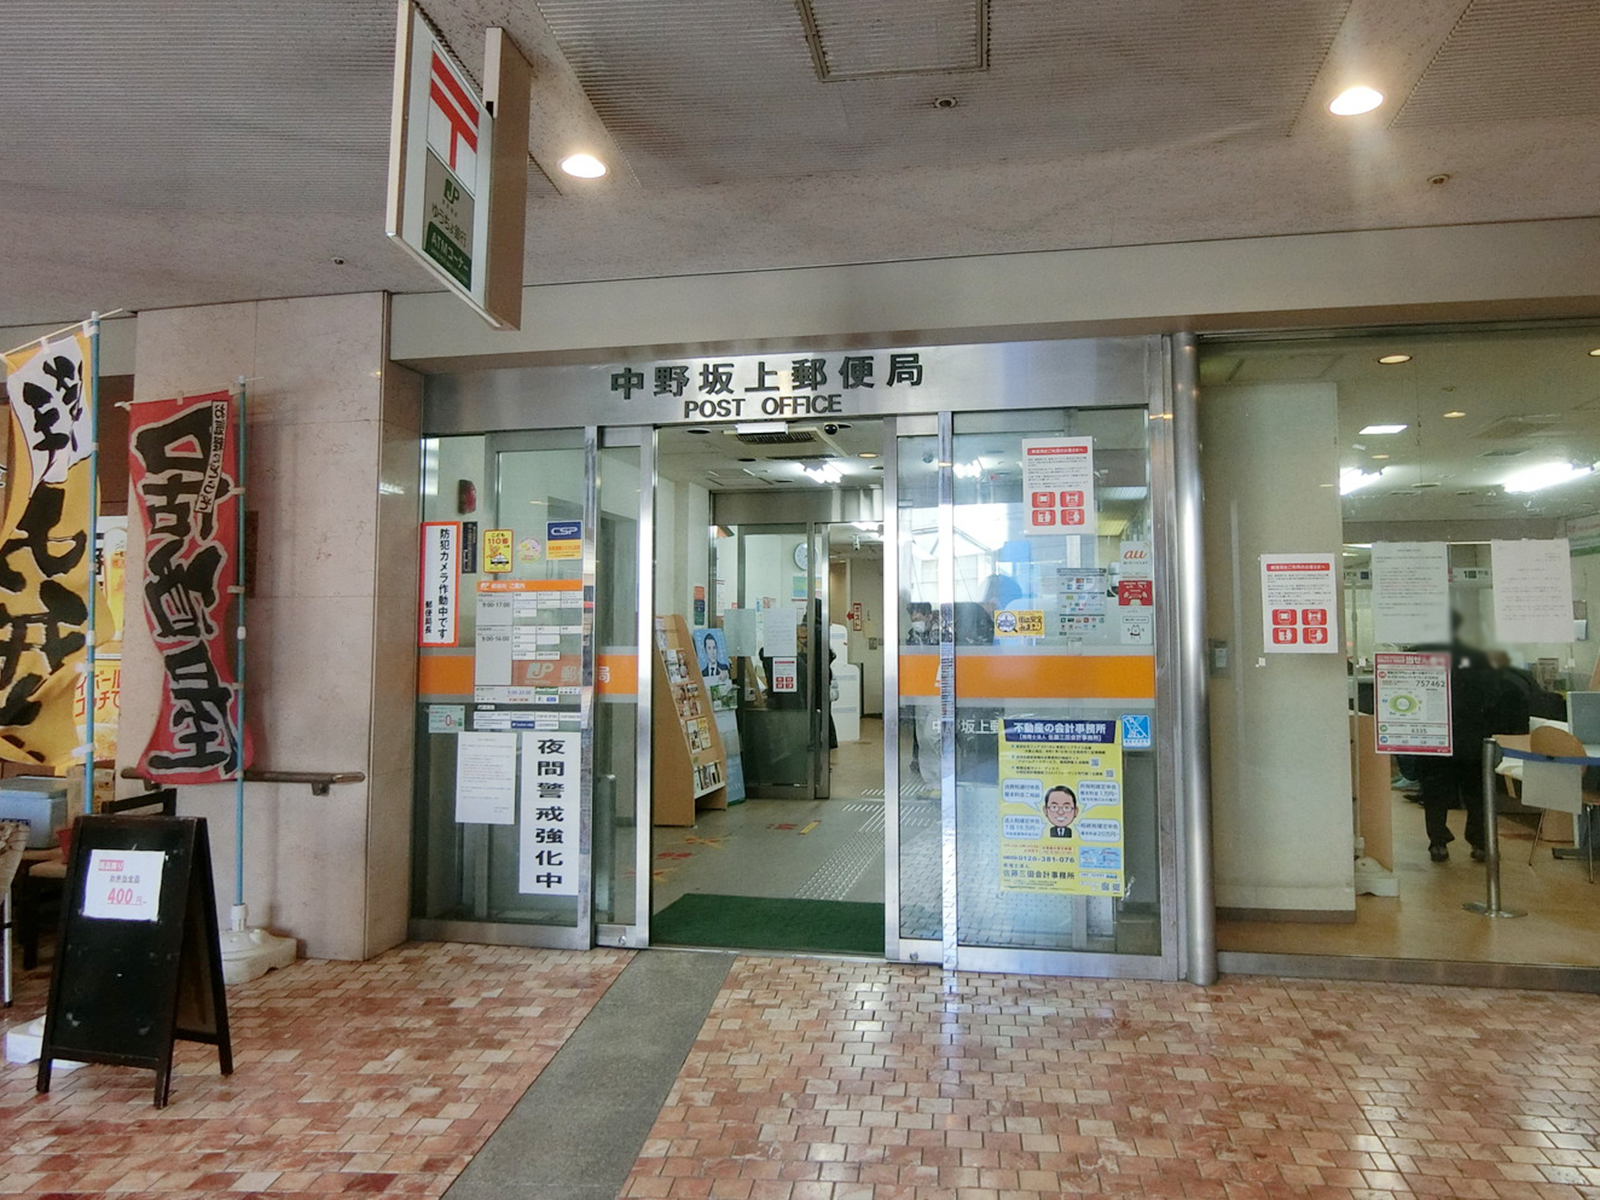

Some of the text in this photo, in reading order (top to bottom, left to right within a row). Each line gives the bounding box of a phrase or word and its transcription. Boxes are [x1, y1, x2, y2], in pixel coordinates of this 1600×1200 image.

[444, 178, 460, 204] JP
[432, 203, 467, 248] ゆうちょ銀行
[431, 232, 469, 271] ATMコーナー
[611, 353, 924, 400] 中野坂上郵便局
[684, 394, 842, 418] POST OFFICE
[551, 526, 578, 536] CSP
[1124, 549, 1147, 559] au
[438, 528, 450, 640] 防犯カメラ作動中です
[425, 601, 433, 634] 郵便局長
[527, 663, 554, 679] JP
[1013, 722, 1106, 734] 不動産の会計事務所
[535, 739, 565, 888] 夜間警戒強化中
[1018, 855, 1075, 863] 0120-381-076
